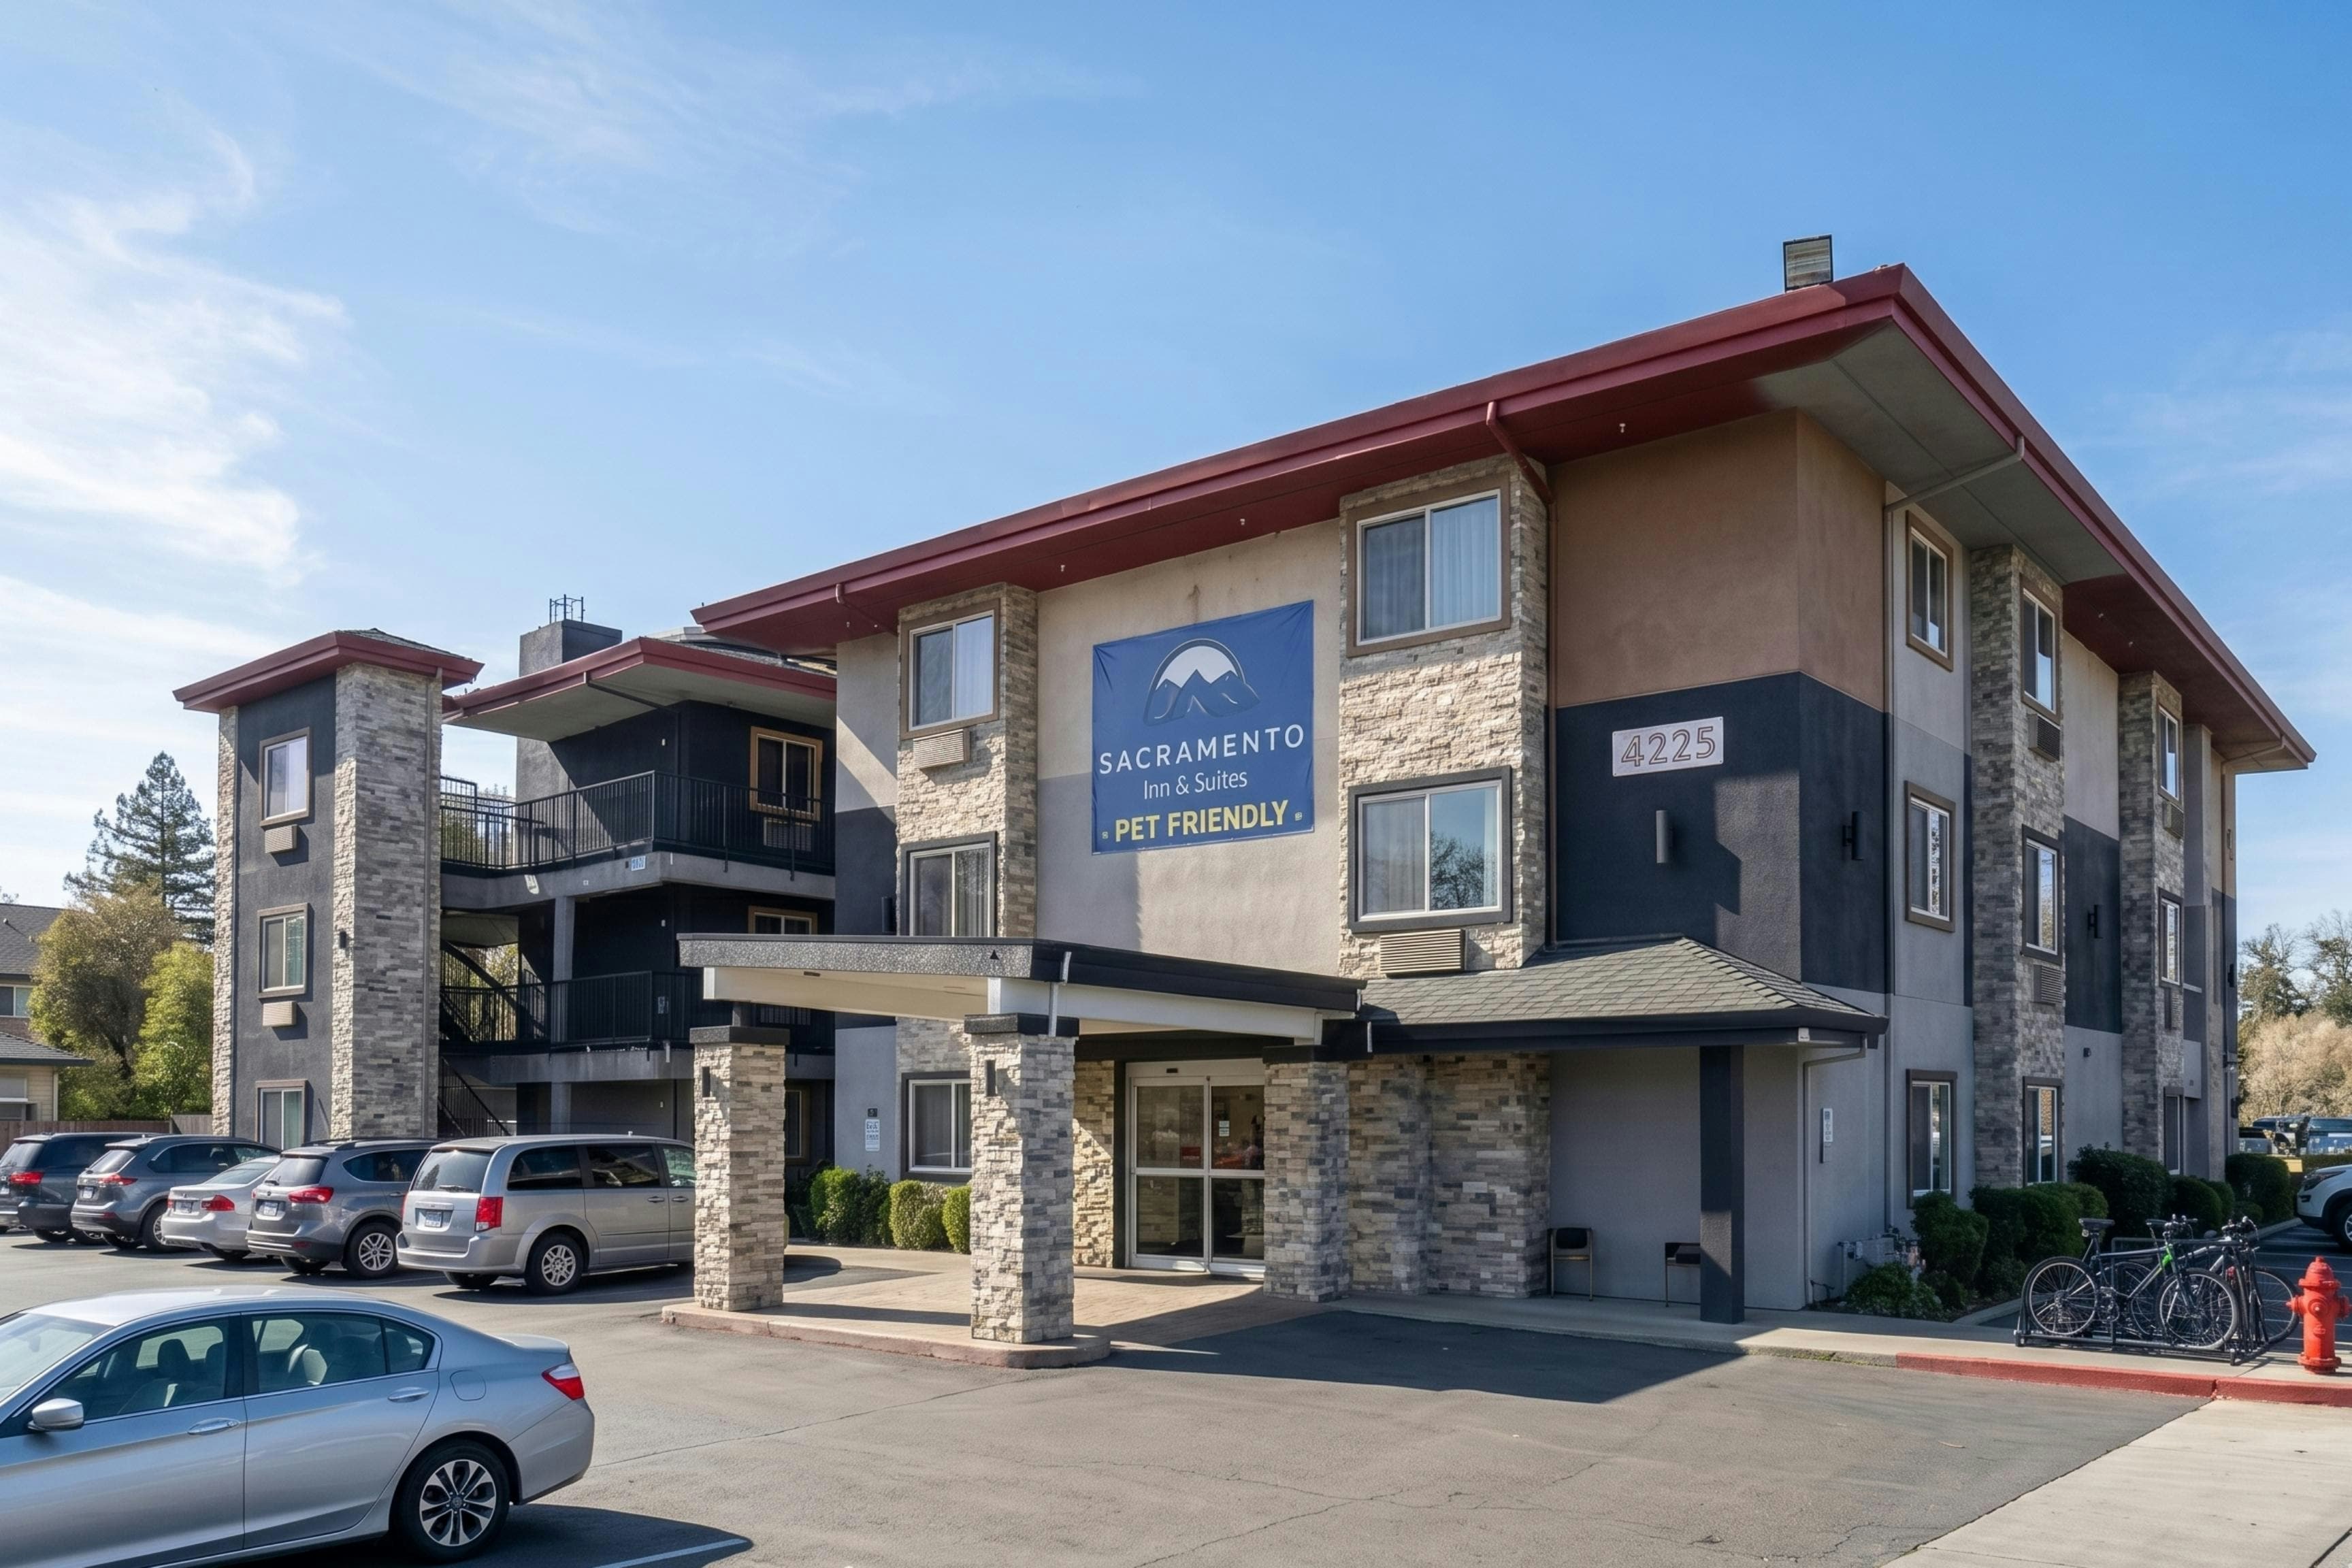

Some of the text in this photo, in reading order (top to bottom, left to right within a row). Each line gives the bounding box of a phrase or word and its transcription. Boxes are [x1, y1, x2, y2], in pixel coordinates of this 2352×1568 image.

[1099, 723, 1304, 774] SACRAMENTO
[1621, 726, 1715, 767] 4225
[1144, 770, 1248, 800] Inn & Suites
[1115, 800, 1288, 843] PET FRIENDLY
